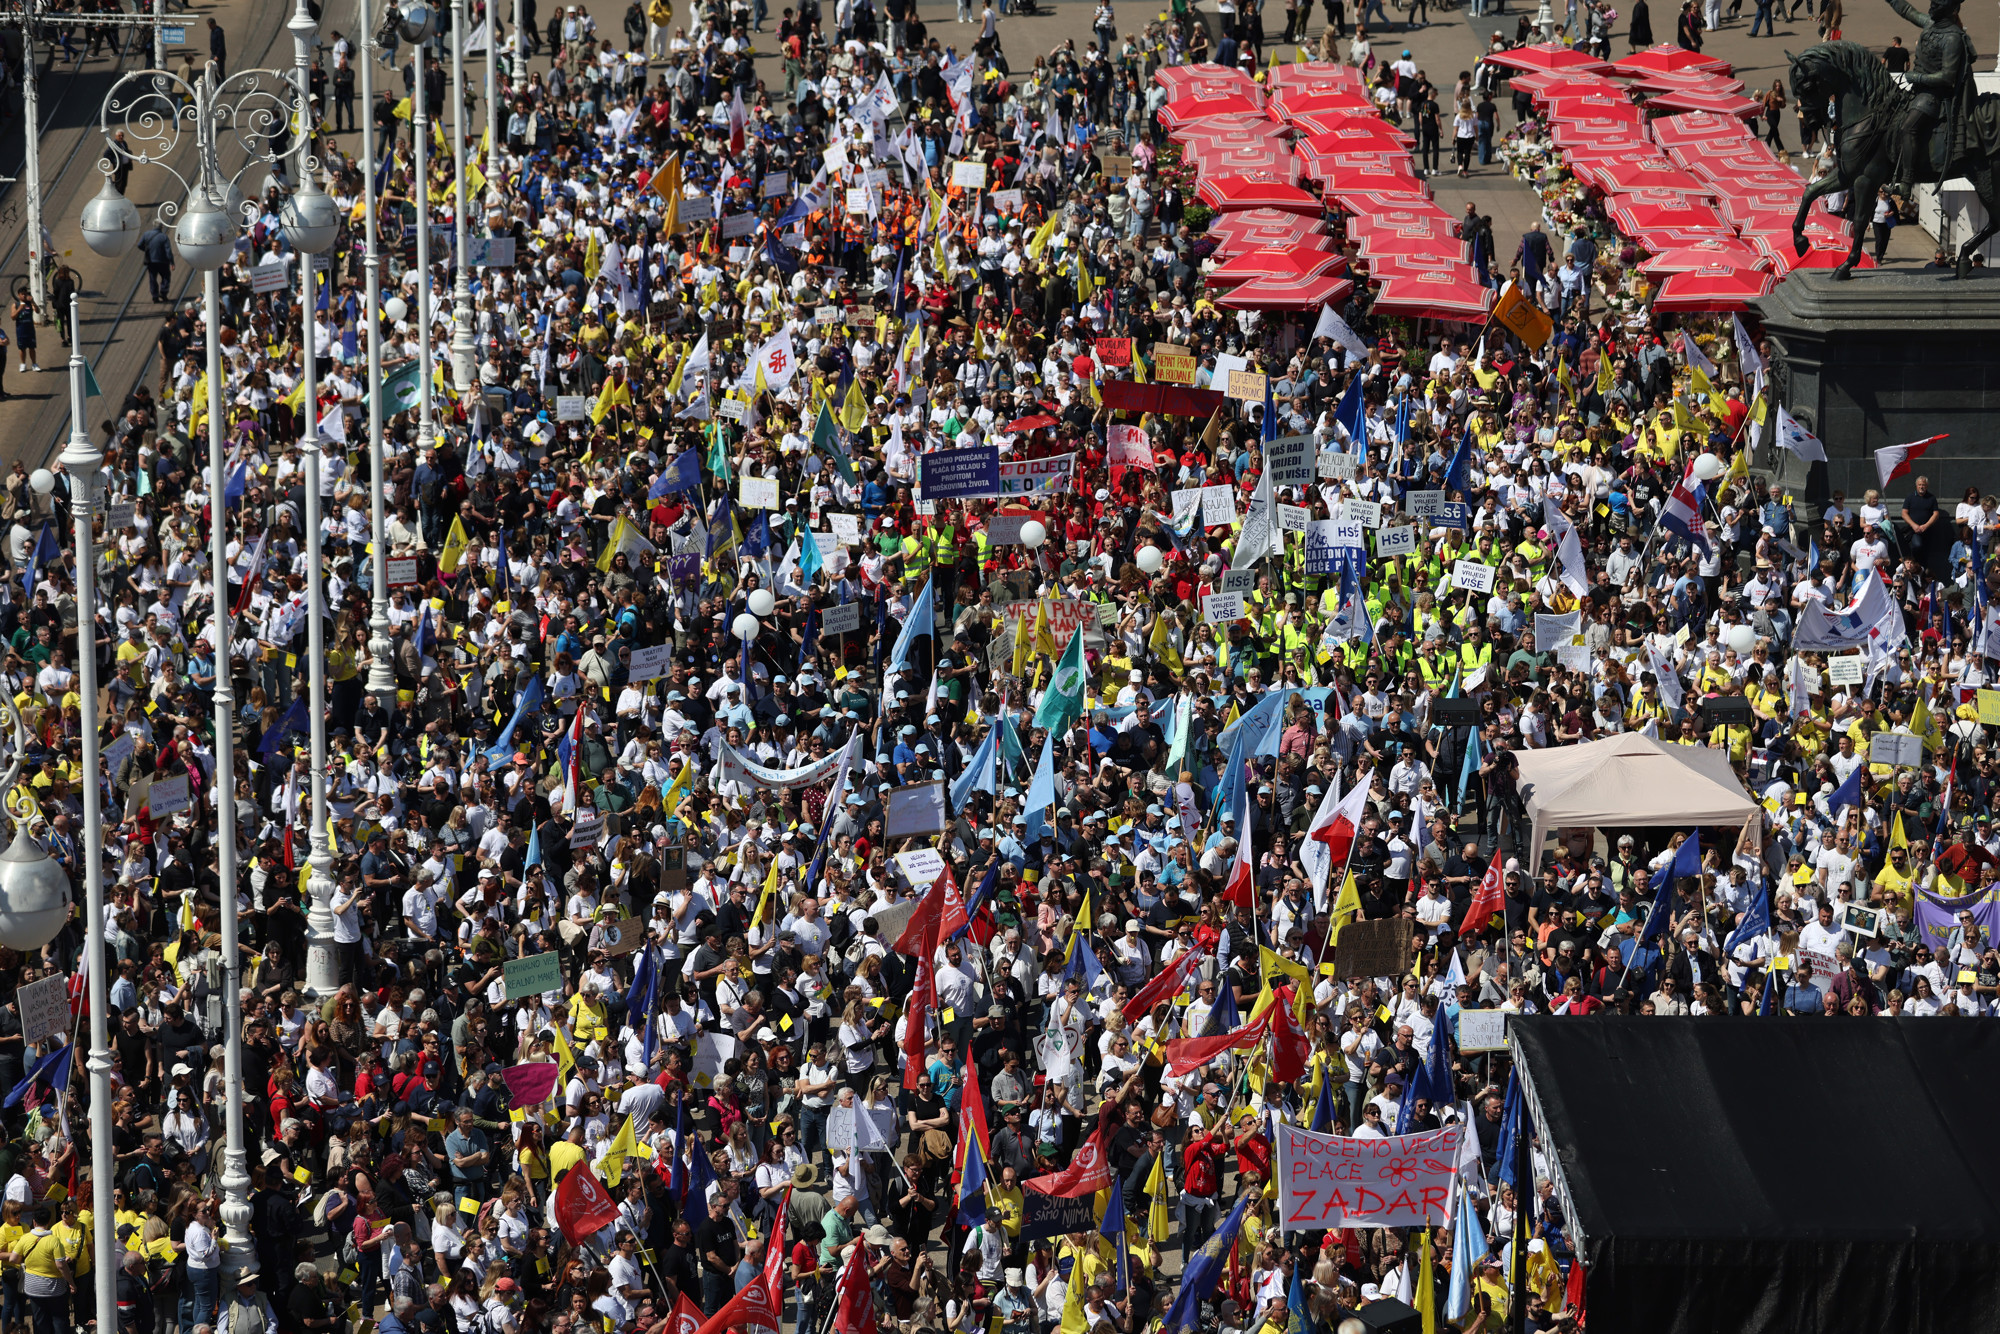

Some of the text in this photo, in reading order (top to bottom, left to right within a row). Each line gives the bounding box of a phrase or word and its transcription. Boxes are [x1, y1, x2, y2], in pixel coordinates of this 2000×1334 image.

[1157, 354, 1194, 370] NEMAM PRAVO
[1156, 368, 1192, 383] NA BOLOVANJE
[1230, 385, 1264, 399] SU RADNICI
[1127, 428, 1143, 443] Mi
[1270, 442, 1304, 457] NAŠ RAD
[928, 452, 991, 467] TRAŽIMO POVEĆANJE
[1270, 455, 1302, 469] VRIJEDI
[931, 461, 987, 475] PLAĆA U SKLADU S
[1017, 463, 1026, 475] O
[1031, 459, 1071, 475] DJECI
[1285, 467, 1310, 479] VIŠE!
[941, 472, 972, 483] PROFITOM
[1024, 478, 1034, 491] O
[929, 478, 990, 493] TROŠKOVIMA ŽIVOTA
[1307, 557, 1330, 572] VEĆE
[1462, 564, 1474, 572] MOJ
[1461, 569, 1486, 578] VRIJEDI
[830, 607, 851, 616] SESTRE
[1052, 600, 1096, 620] PLAĆE
[1211, 601, 1236, 610] VRIJEDI
[825, 613, 857, 625] ZASLUŽUJU
[831, 623, 852, 632] VIŠE!!!
[642, 647, 663, 657] VRATITE
[645, 654, 658, 662] NAM
[505, 955, 557, 975] NOMINALNO VIŠE
[506, 975, 535, 990] REALNO
[537, 972, 554, 984] MANJE
[1290, 1130, 1457, 1159] HOĆEMO VEĆE
[1292, 1159, 1365, 1183] PLAĆE
[1288, 1186, 1451, 1223] ZADAR
[1034, 1209, 1059, 1221] SAMO
